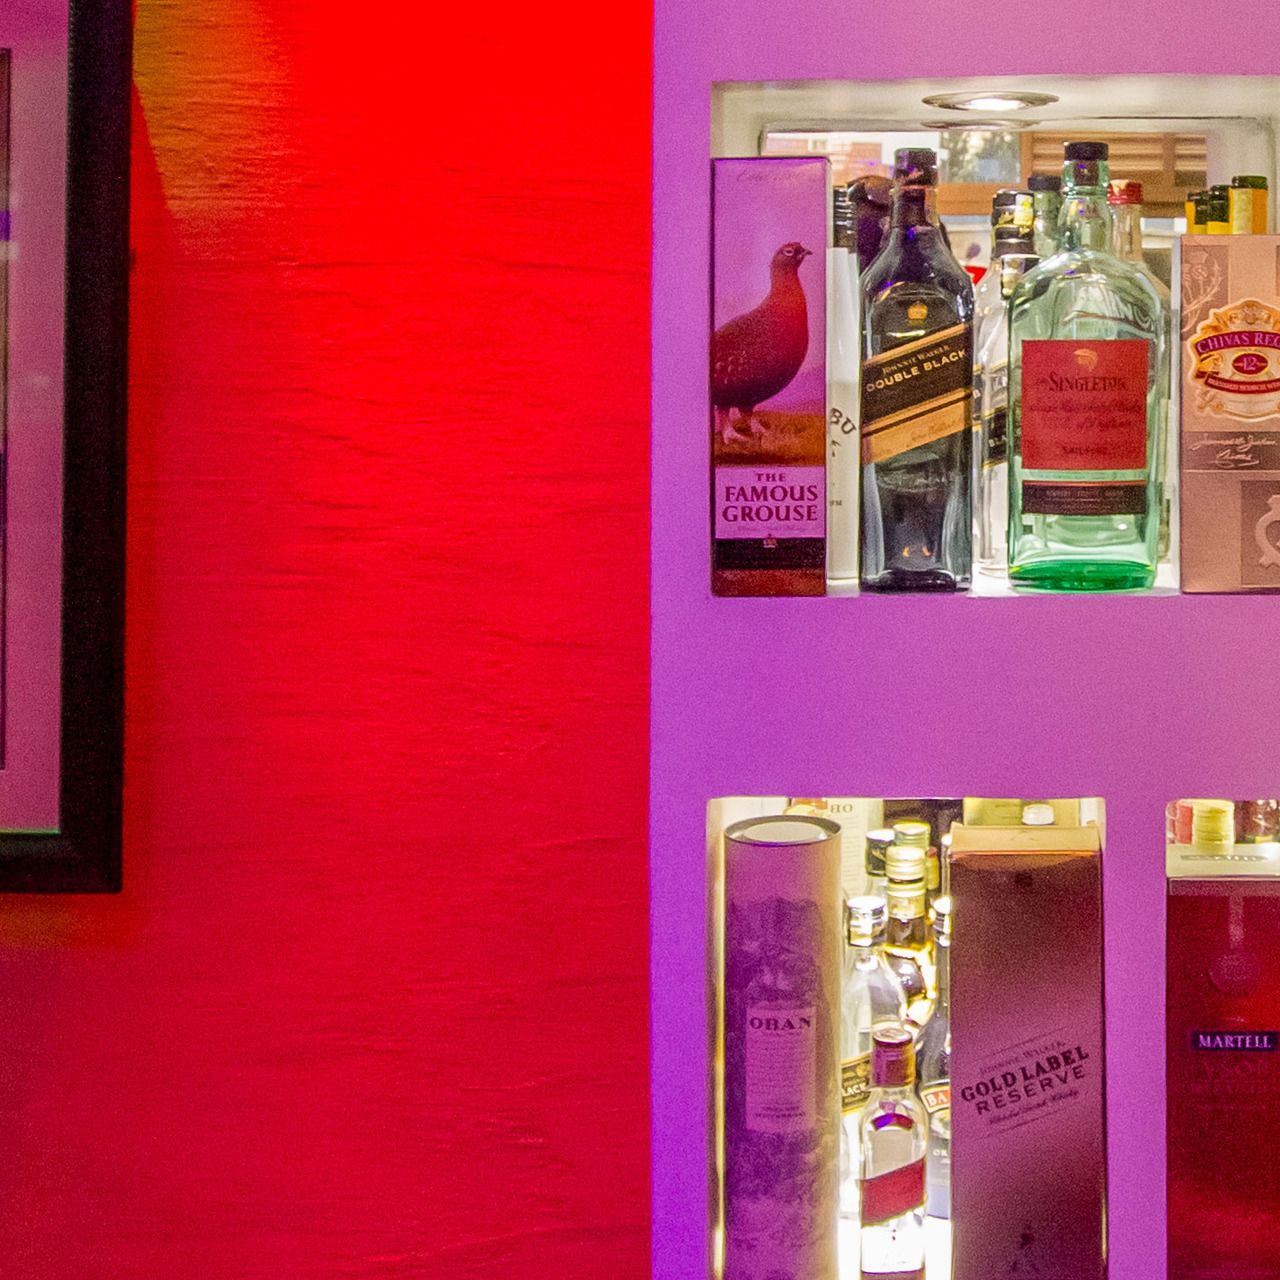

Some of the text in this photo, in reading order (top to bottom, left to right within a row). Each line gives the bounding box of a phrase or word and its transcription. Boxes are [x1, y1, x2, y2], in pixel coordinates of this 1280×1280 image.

[1197, 334, 1250, 354] CHIVAS
[866, 349, 967, 392] DOUBLE BLACK
[1242, 356, 1258, 371] 12
[756, 473, 787, 482] THE
[725, 485, 819, 502] FAMOUS
[722, 505, 819, 522] GROUSE
[1199, 1034, 1272, 1049] MARTELL
[961, 1046, 1090, 1103] GOLD LABEL
[841, 1082, 867, 1097] LACK
[975, 1065, 1086, 1115] RESERVE
